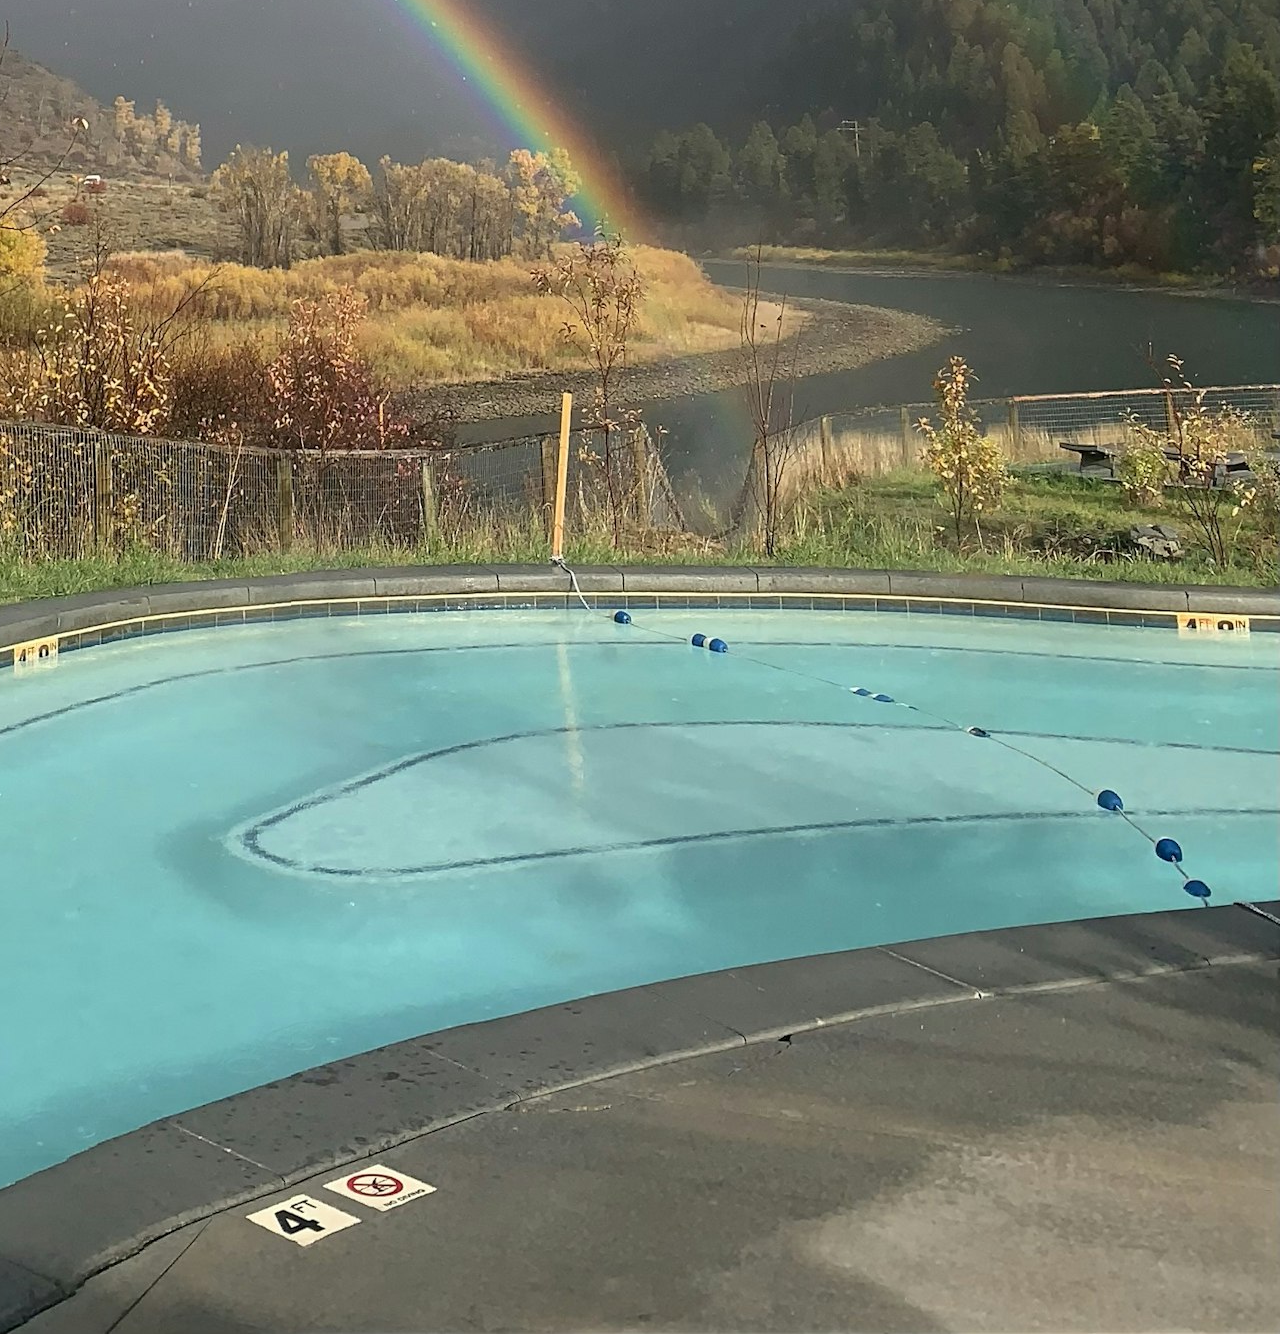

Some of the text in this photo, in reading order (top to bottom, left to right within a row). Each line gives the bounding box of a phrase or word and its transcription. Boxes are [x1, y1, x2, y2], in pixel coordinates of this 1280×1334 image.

[1235, 620, 1246, 628] IN
[383, 1188, 426, 1208] NO DIVING
[274, 1198, 326, 1235] 4 FT
